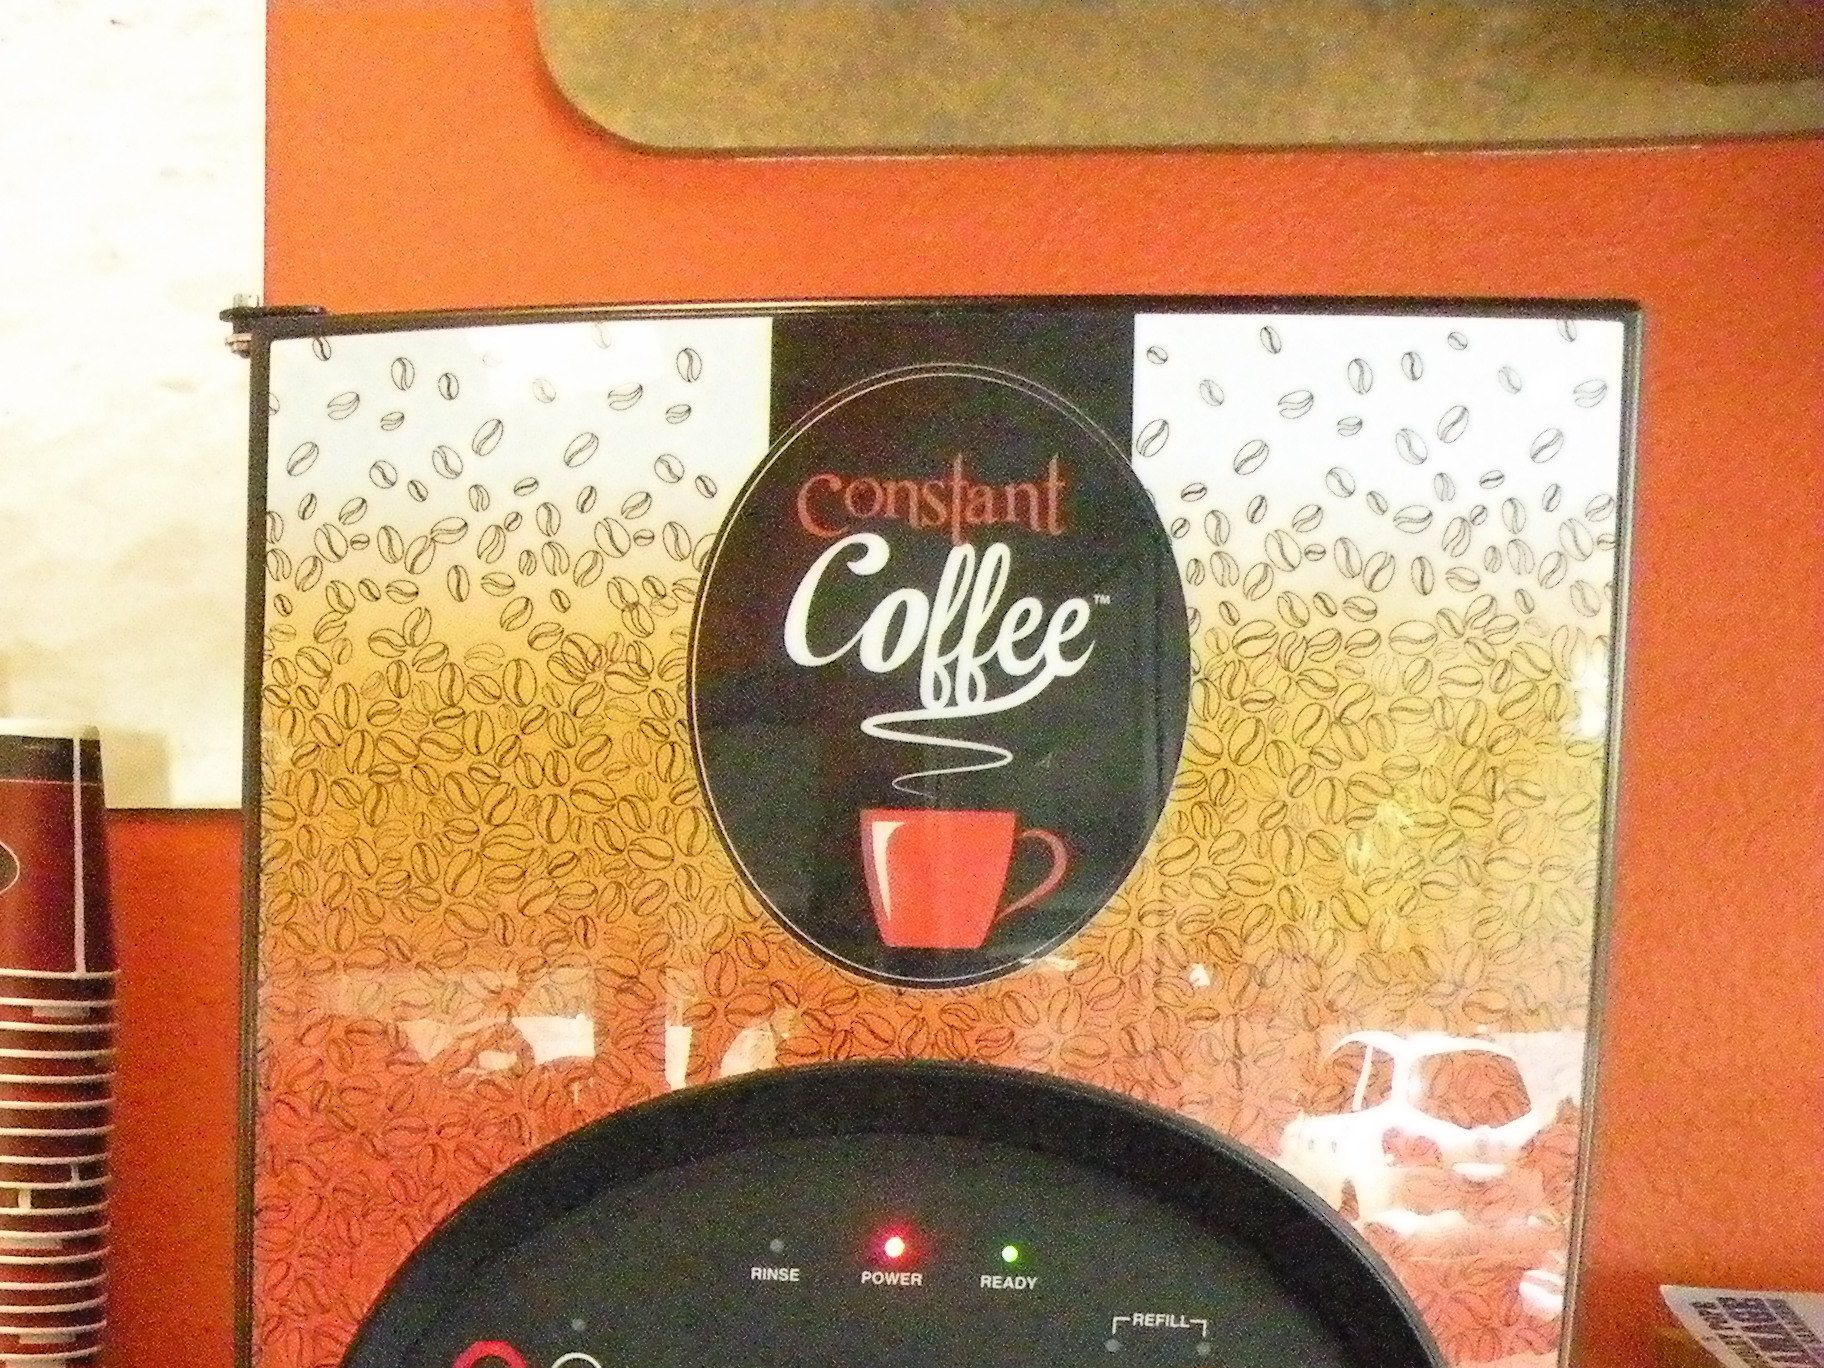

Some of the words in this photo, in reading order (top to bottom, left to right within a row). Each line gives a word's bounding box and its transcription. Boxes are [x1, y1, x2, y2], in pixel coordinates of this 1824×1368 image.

[797, 452, 1069, 546] constant
[784, 533, 1097, 711] Coffee
[751, 1267, 801, 1283] RINSE
[861, 1271, 923, 1287] POWER
[980, 1274, 1038, 1290] READY
[1132, 1313, 1190, 1329] REFILL
